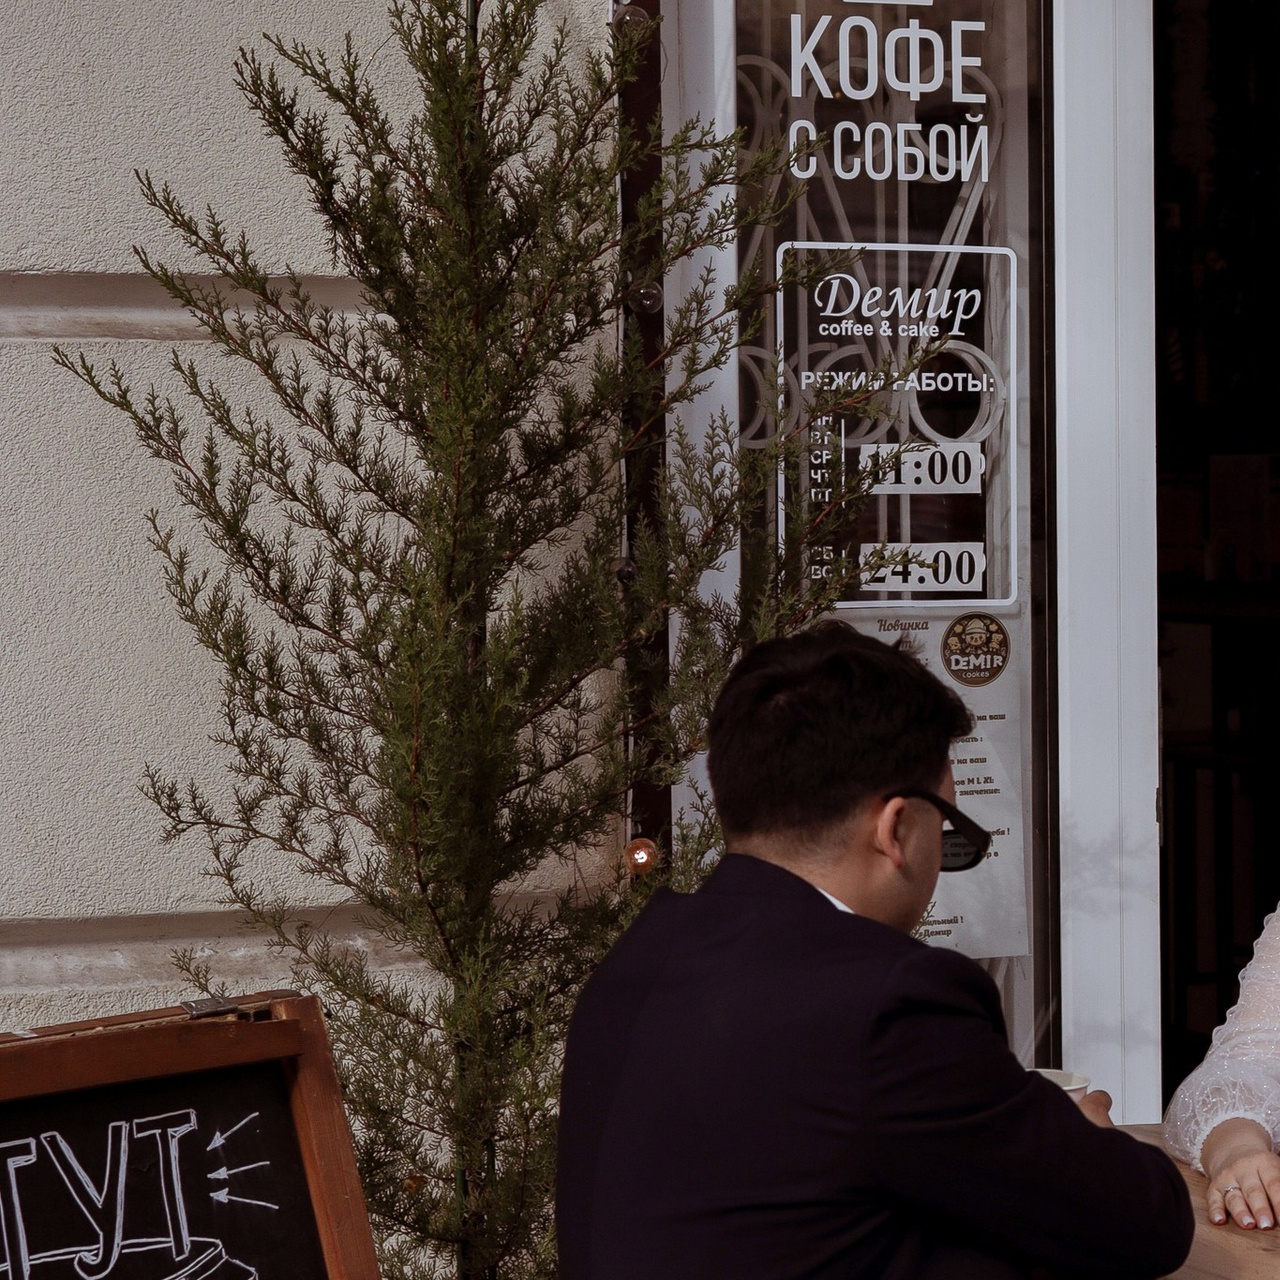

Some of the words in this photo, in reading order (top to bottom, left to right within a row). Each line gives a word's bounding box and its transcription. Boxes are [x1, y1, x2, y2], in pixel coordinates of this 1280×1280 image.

[790, 13, 987, 103] КОФЕ
[789, 120, 817, 179] С
[833, 113, 989, 182] СОБОЙ
[814, 273, 981, 336] Демир
[818, 320, 874, 336] coffee
[879, 320, 893, 336] &
[898, 321, 939, 337] cake
[877, 618, 930, 632] Новинка
[950, 654, 1004, 670] DEMIR
